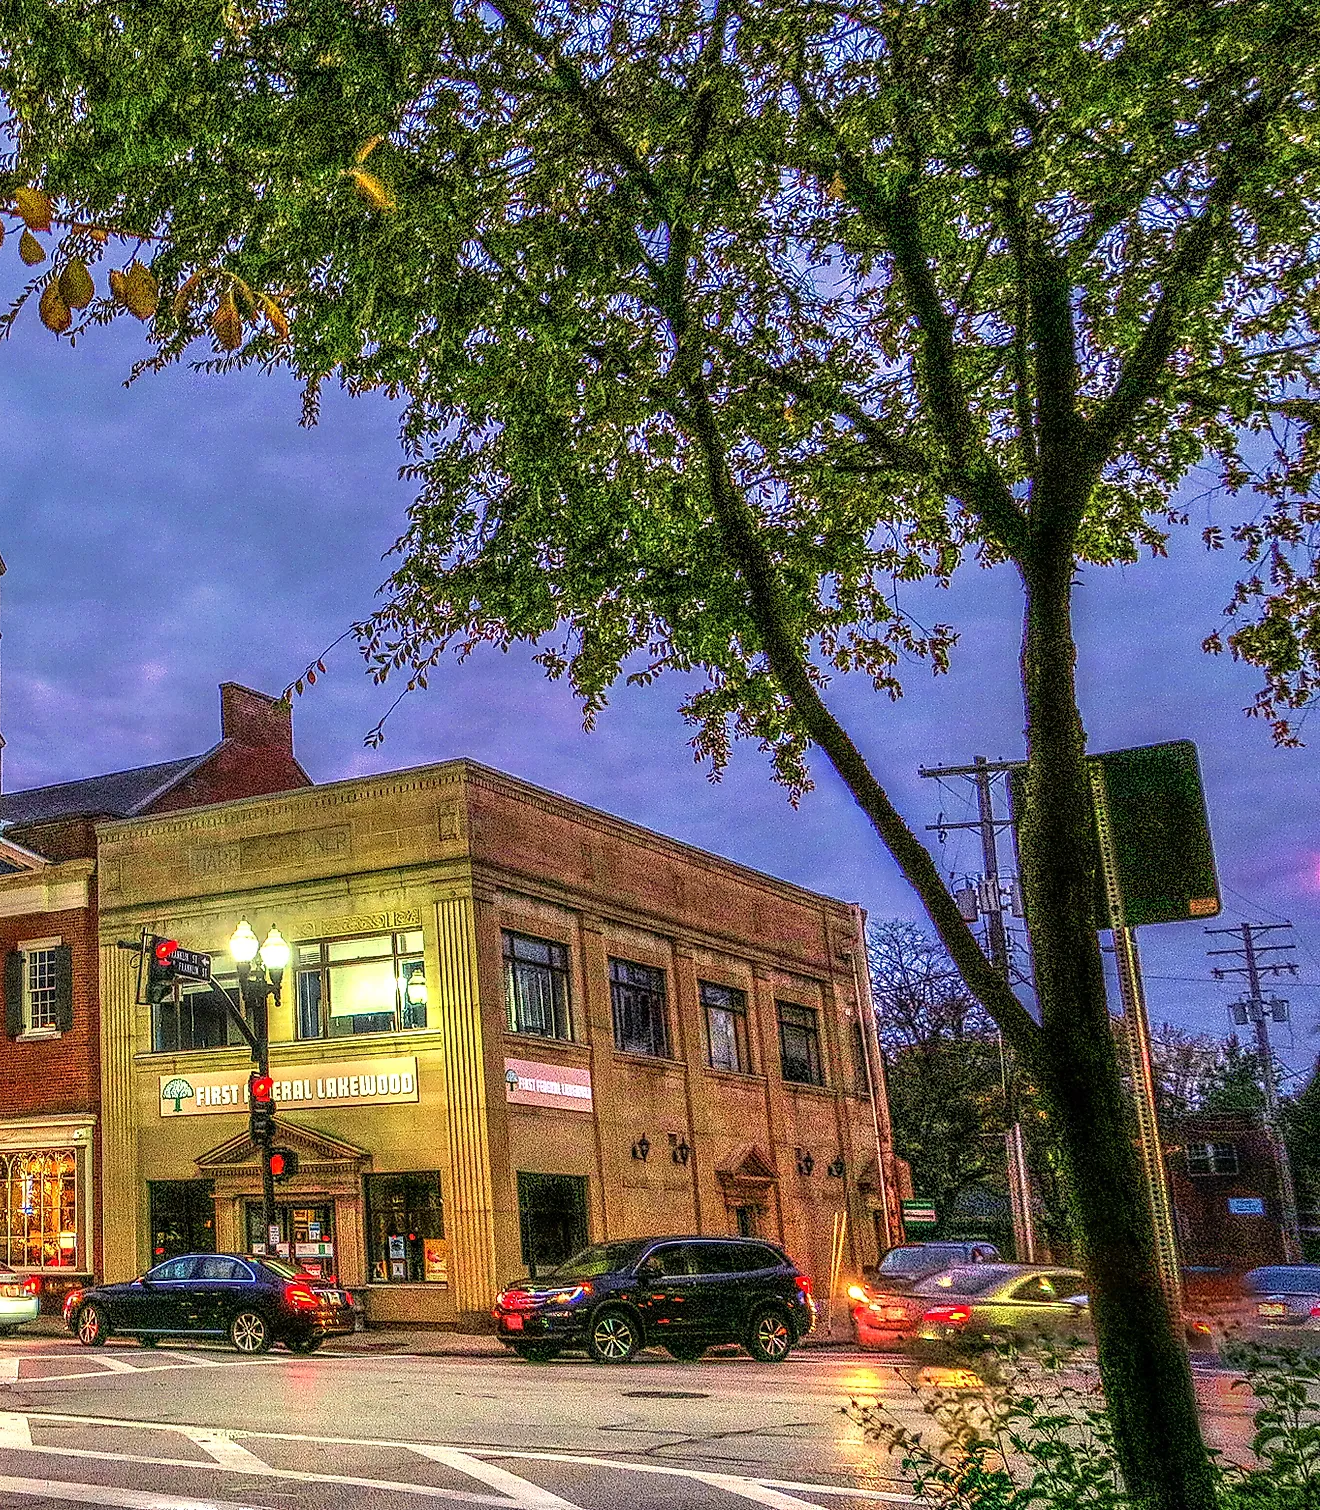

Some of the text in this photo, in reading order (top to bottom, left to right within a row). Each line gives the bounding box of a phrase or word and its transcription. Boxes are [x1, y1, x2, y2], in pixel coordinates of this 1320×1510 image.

[196, 1072, 414, 1107] FIRST FERAL LAKEWOOD
